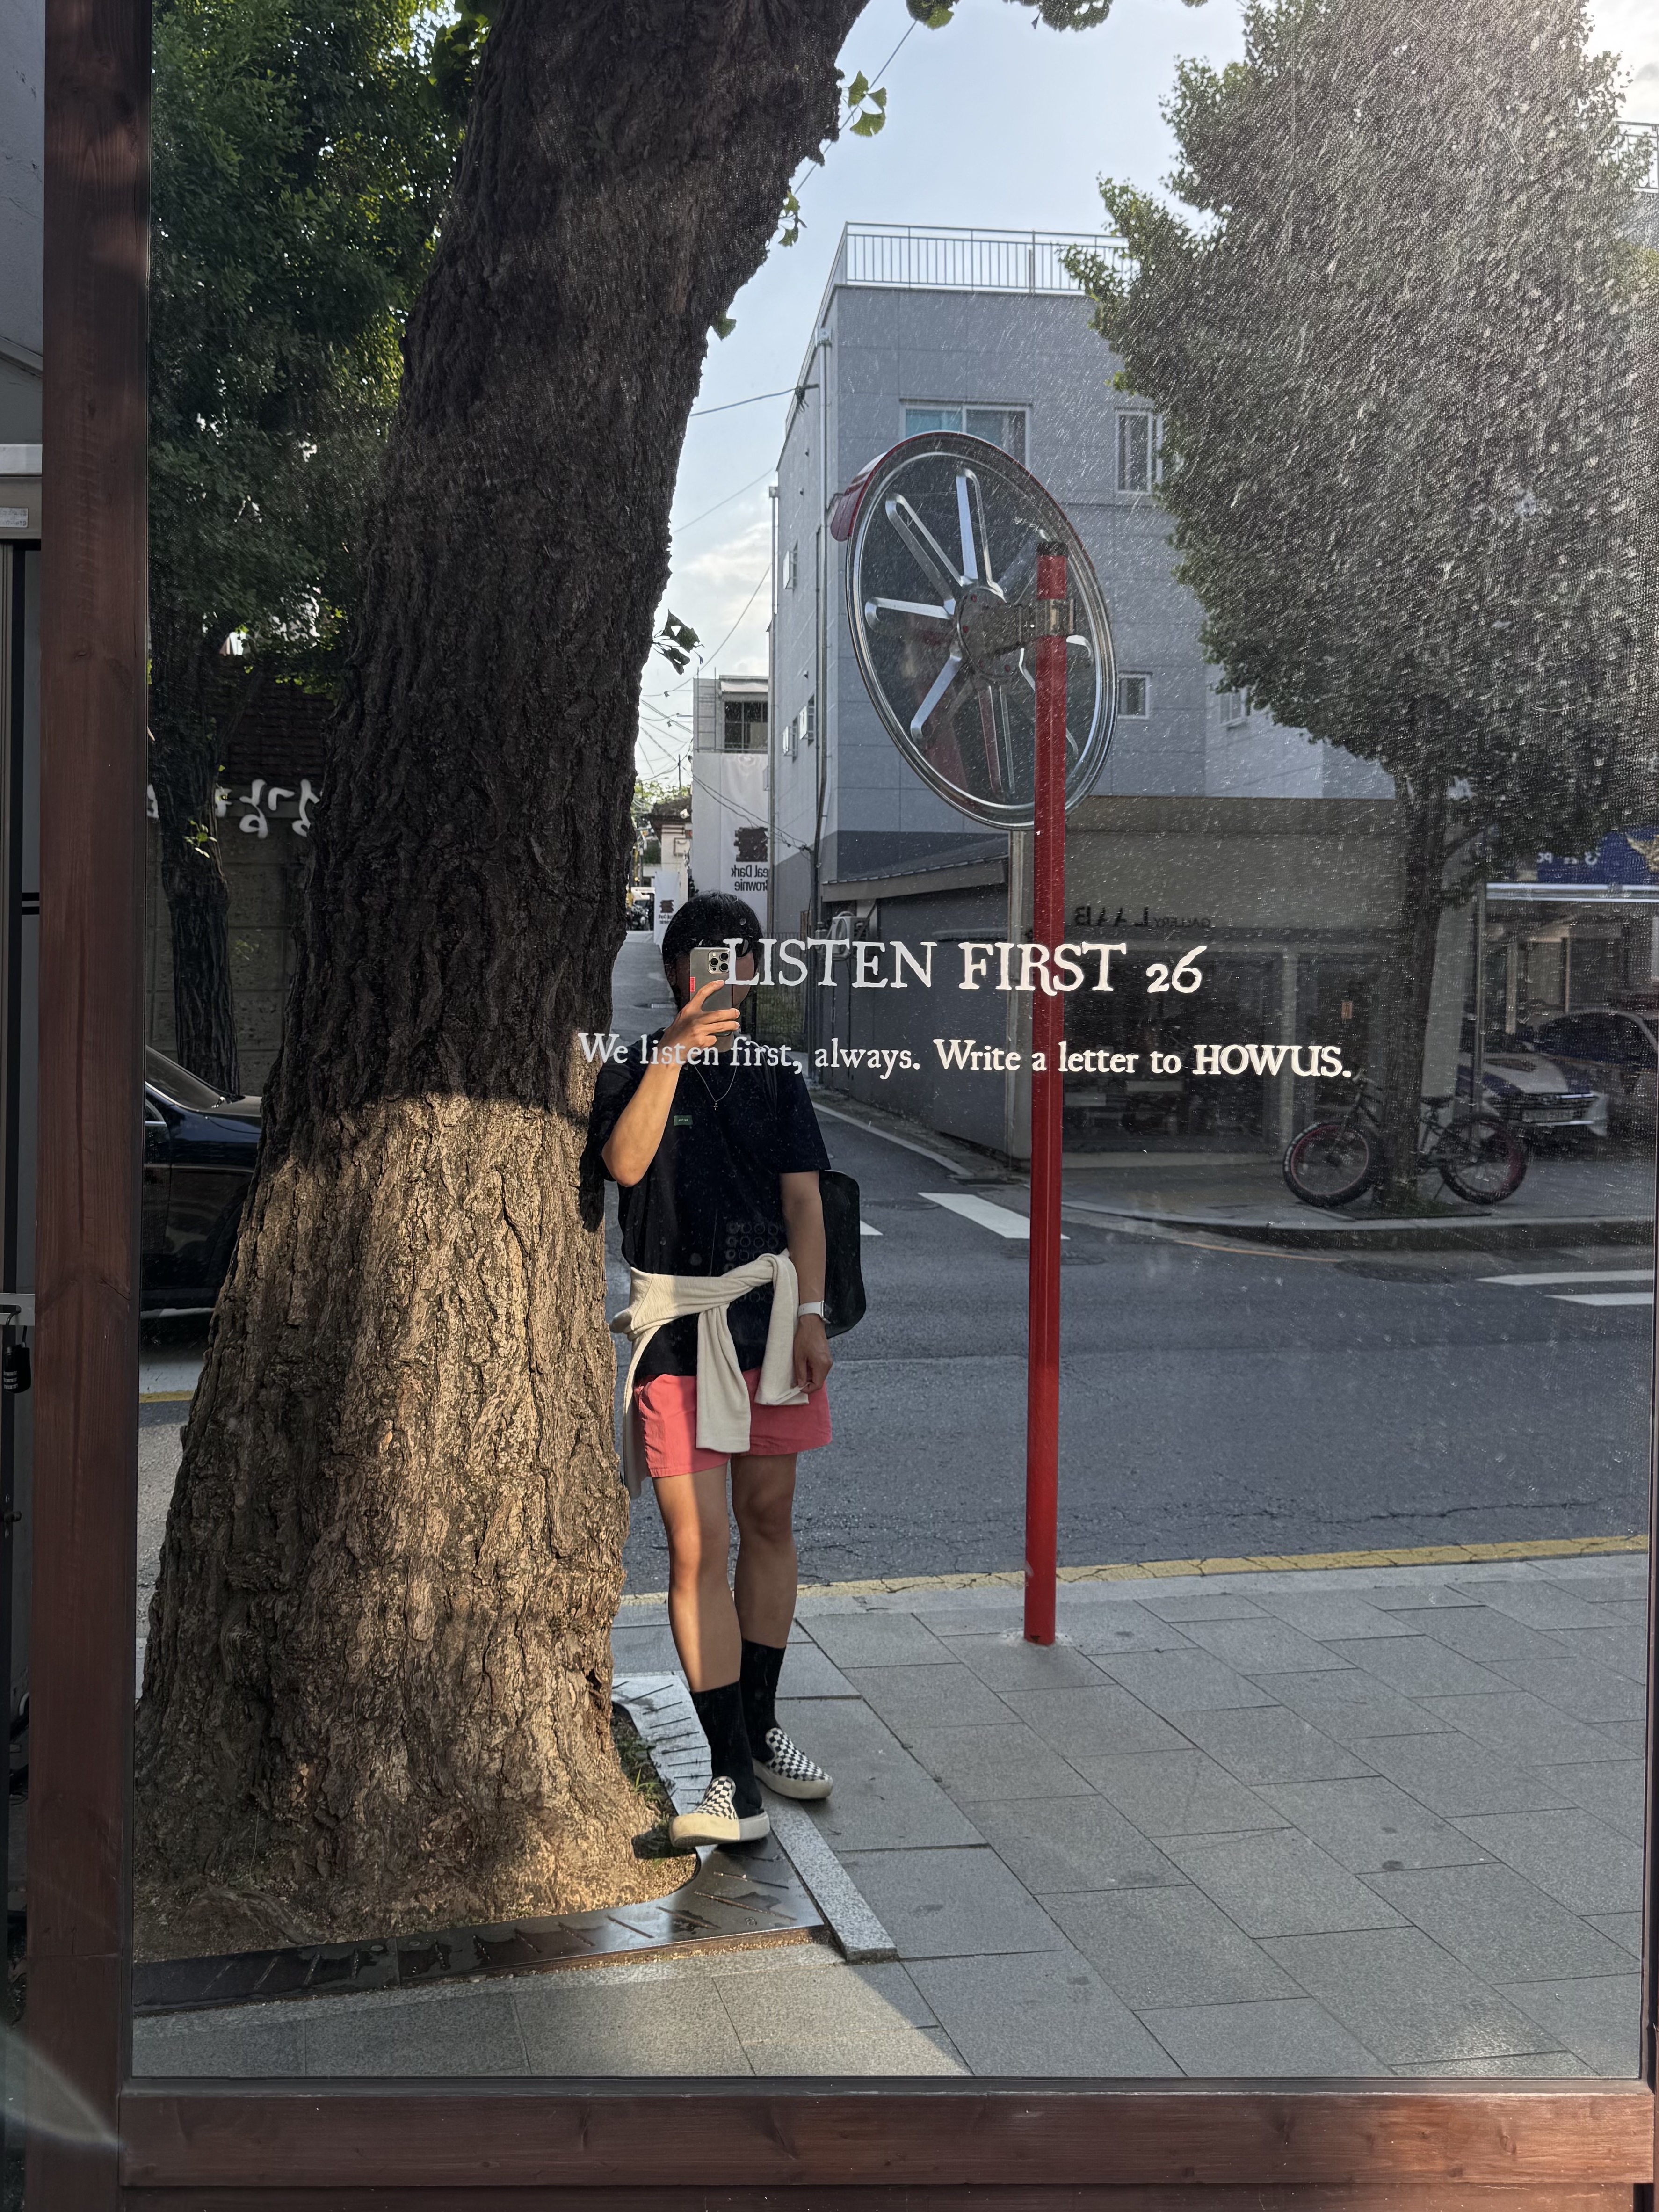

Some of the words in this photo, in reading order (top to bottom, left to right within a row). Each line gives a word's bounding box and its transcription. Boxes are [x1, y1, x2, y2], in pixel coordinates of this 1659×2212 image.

[723, 937, 937, 988] LISTEN
[958, 941, 1127, 996] FIRST
[1146, 945, 1207, 994] 26
[578, 1033, 628, 1064] We
[641, 1034, 719, 1066] listen
[729, 1036, 803, 1075] first,
[814, 1038, 920, 1080] always.
[932, 1039, 1021, 1071] Write
[1032, 1048, 1047, 1071] a
[1058, 1041, 1139, 1074] letter
[1150, 1050, 1181, 1075] to
[1192, 1044, 1352, 1078] HOWUS.
